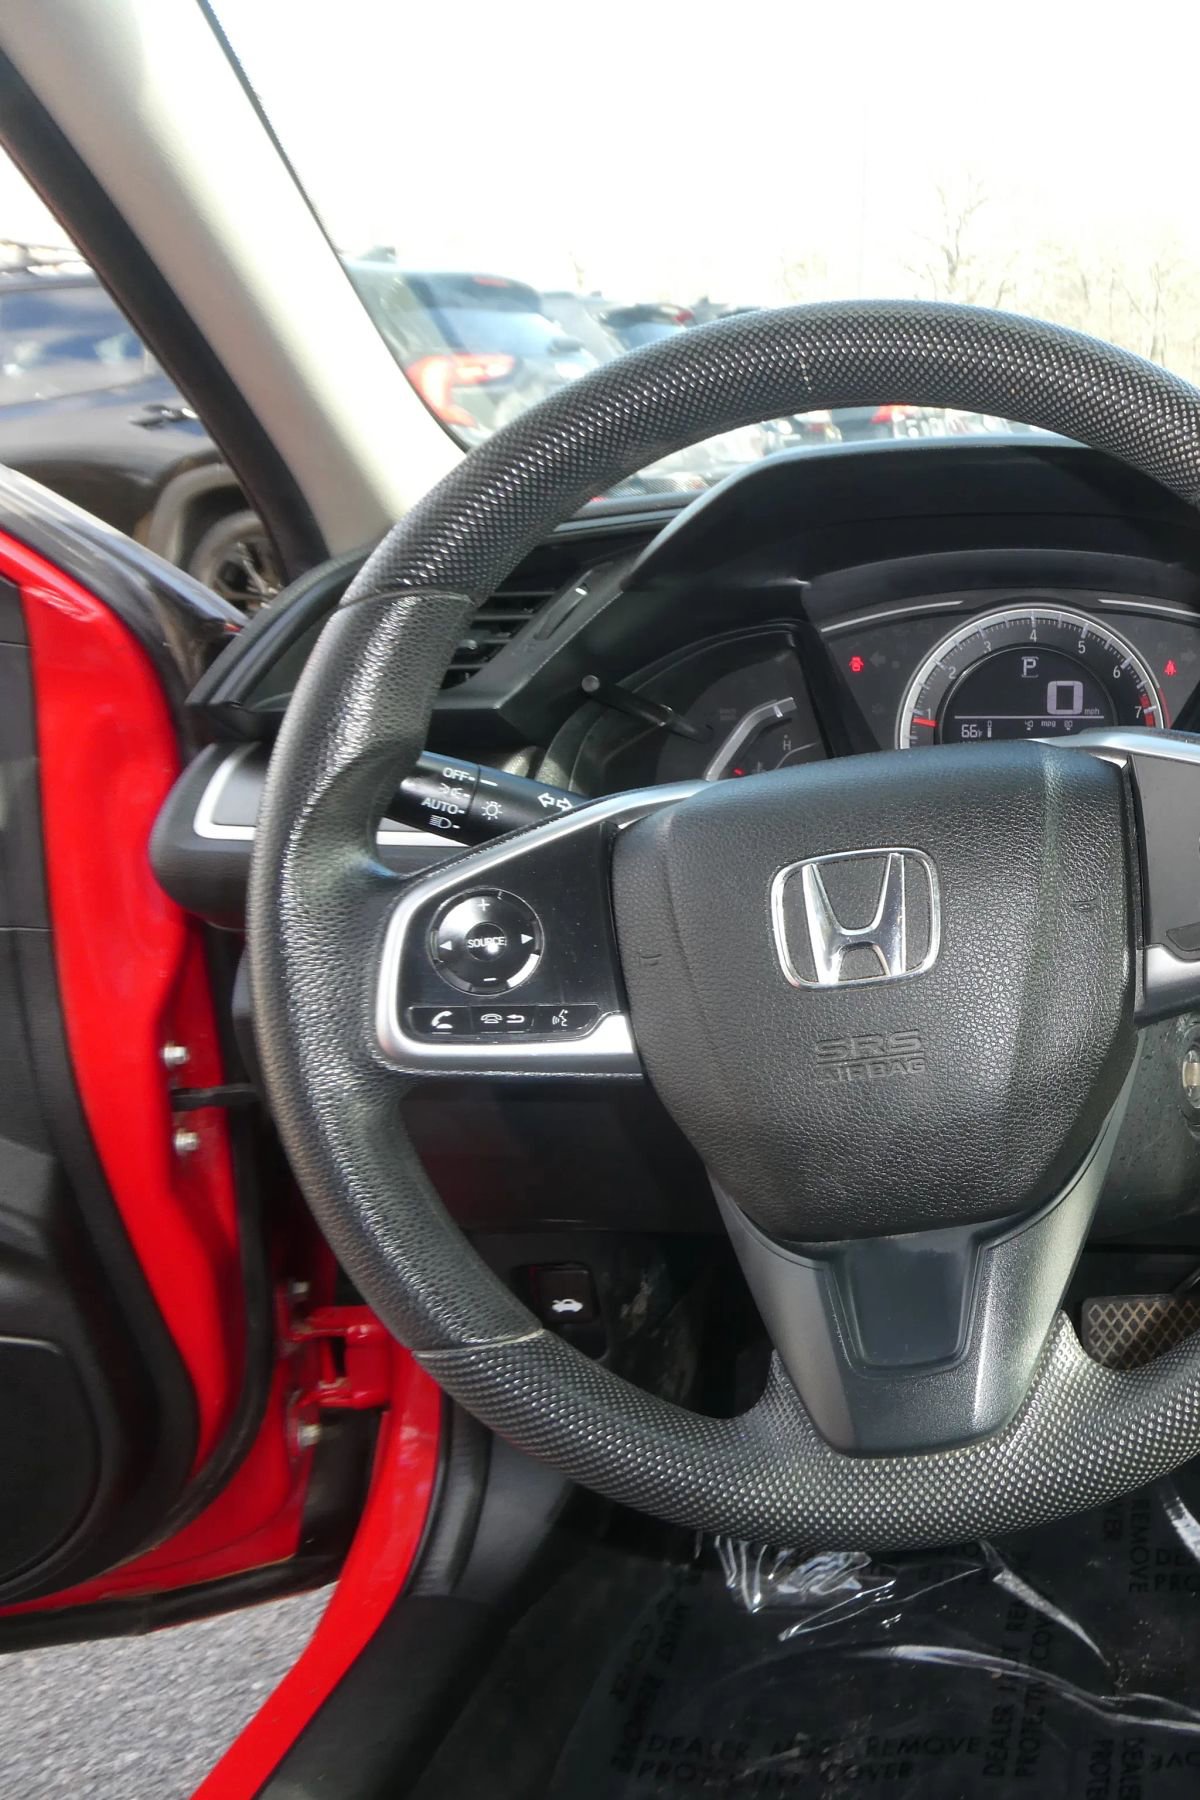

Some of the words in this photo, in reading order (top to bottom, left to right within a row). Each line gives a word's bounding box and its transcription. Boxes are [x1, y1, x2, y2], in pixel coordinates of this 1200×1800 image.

[1029, 629, 1038, 642] 4
[983, 641, 992, 652] 3
[1078, 641, 1086, 654] 5
[948, 667, 957, 680] 2
[1022, 657, 1037, 677] P
[1112, 666, 1121, 679] 6
[1046, 680, 1084, 715] 0
[1084, 707, 1100, 716] mph
[1134, 705, 1142, 719] 7
[1024, 720, 1034, 728] 40
[442, 767, 468, 781] OFF
[421, 796, 458, 814] AUTO
[467, 935, 505, 948] SOURCE
[816, 1029, 922, 1060] SRS
